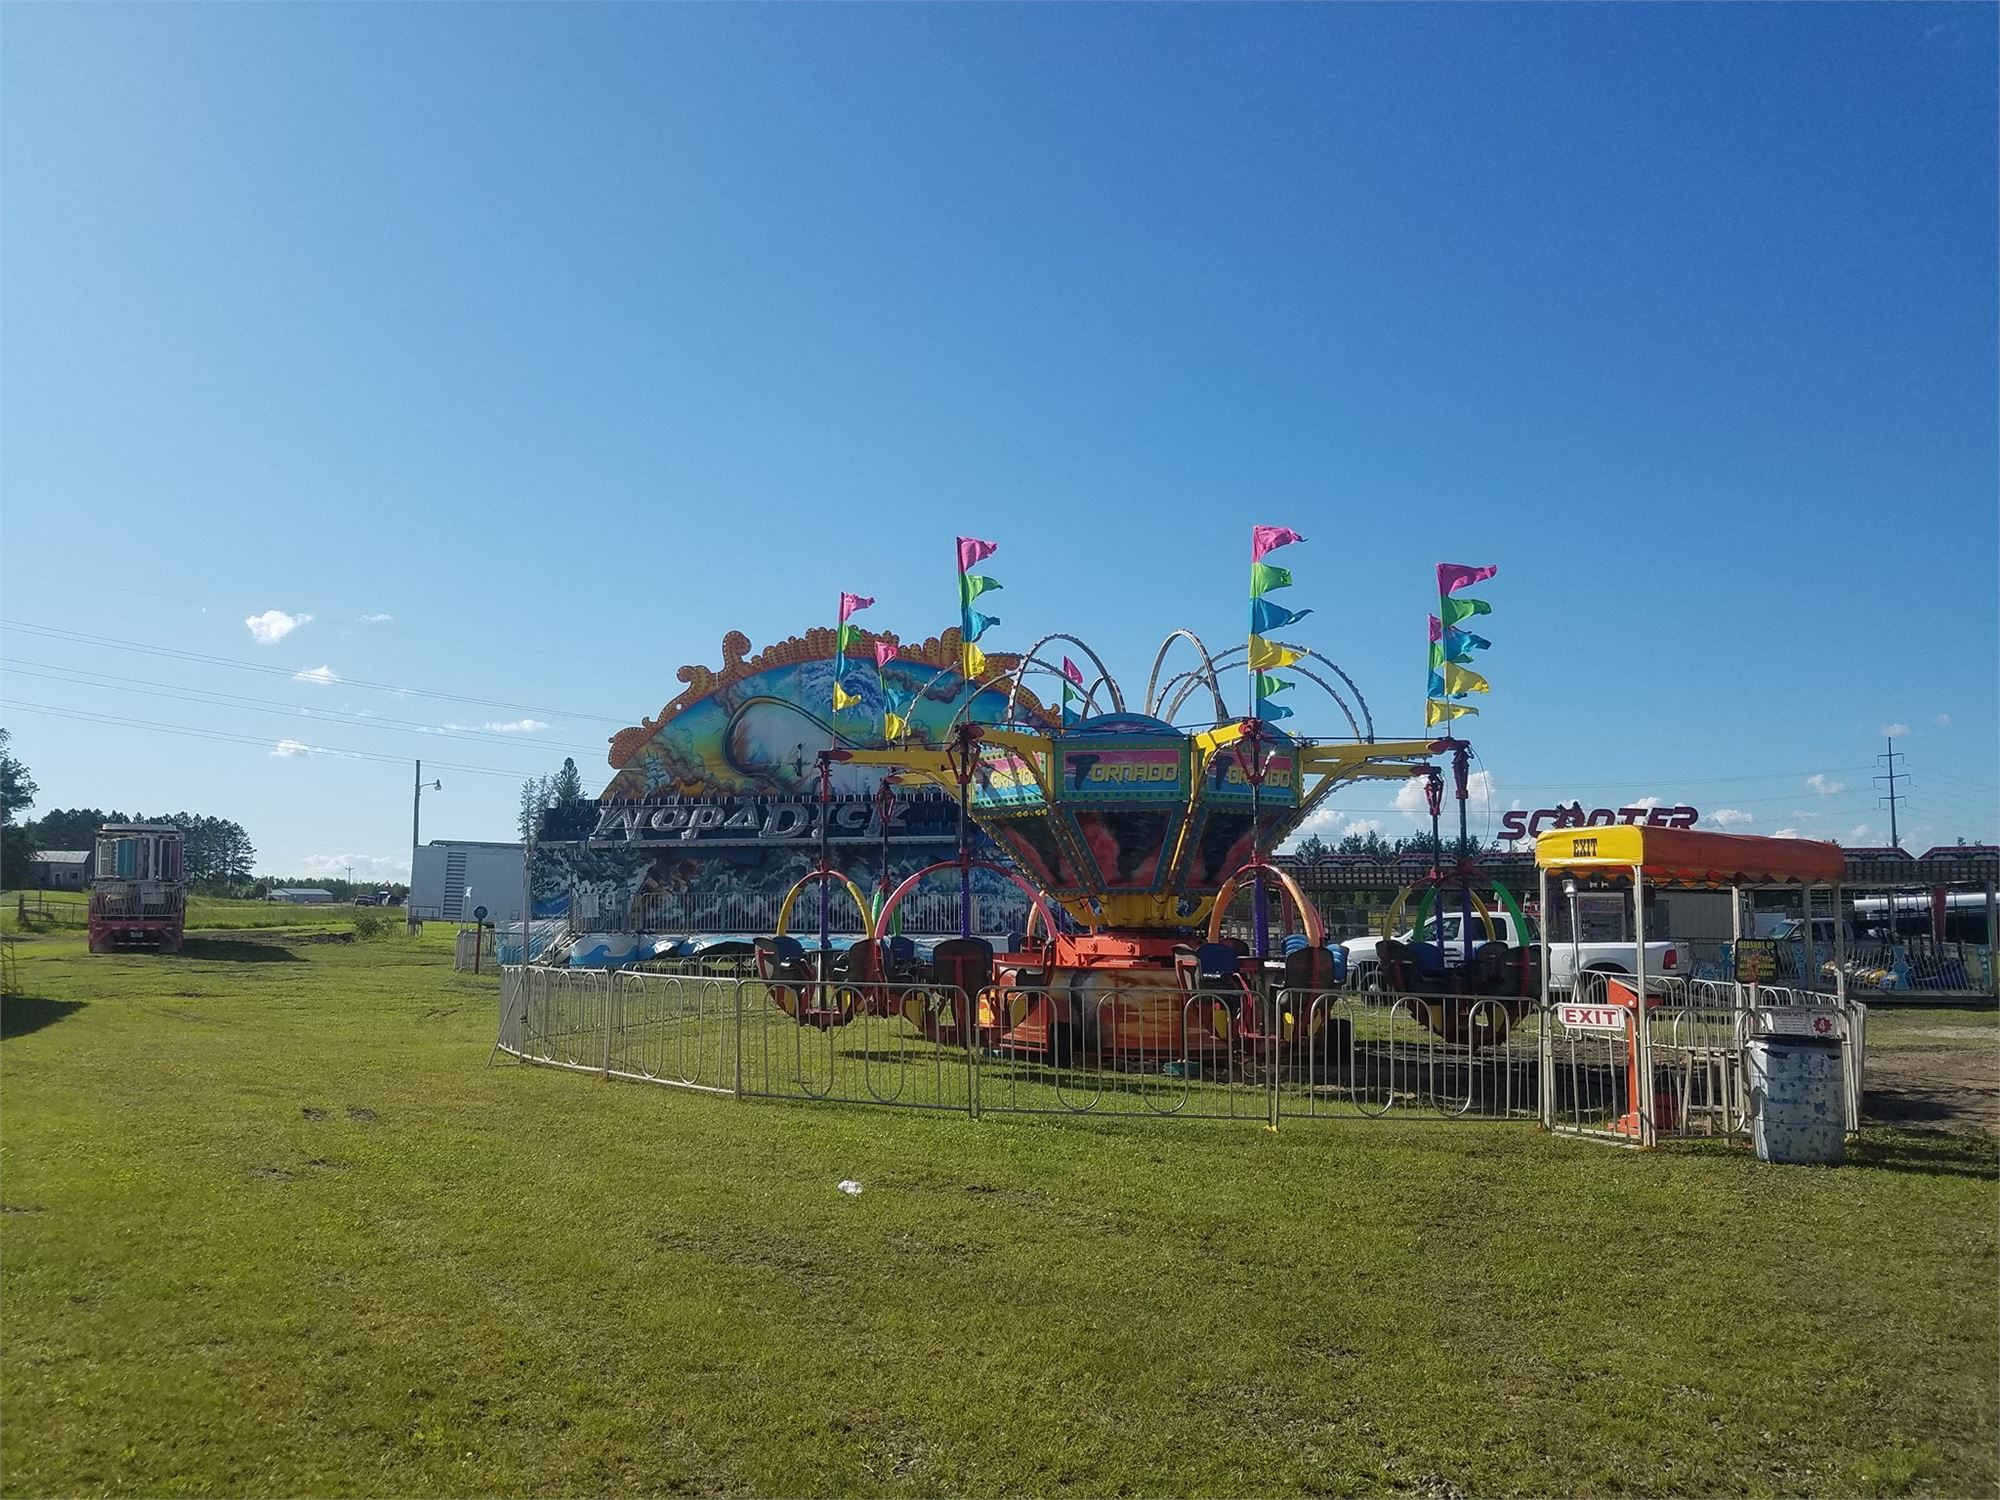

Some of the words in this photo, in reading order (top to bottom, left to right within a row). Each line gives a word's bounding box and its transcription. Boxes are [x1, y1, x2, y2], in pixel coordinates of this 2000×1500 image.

[1497, 806, 1699, 841] SCOOTER
[1573, 838, 1598, 858] EXIT
[1565, 1009, 1616, 1025] EXIT
